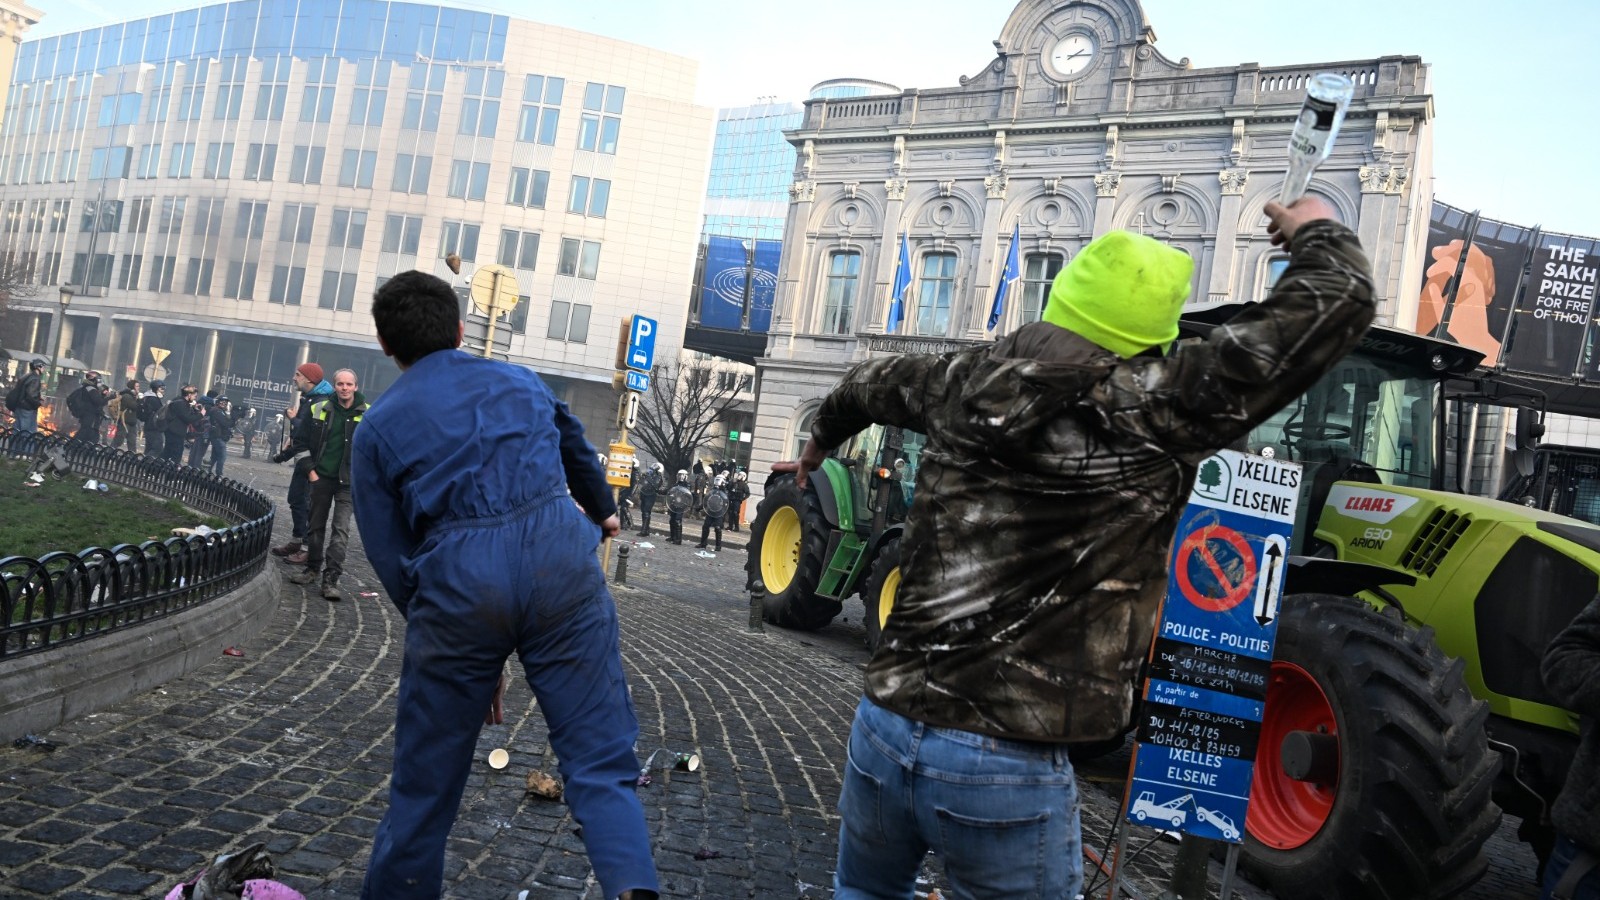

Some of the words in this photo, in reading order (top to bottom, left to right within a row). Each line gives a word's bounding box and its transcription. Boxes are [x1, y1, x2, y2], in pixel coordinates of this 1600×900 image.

[1548, 244, 1587, 264] THE
[1543, 262, 1597, 283] SAKH
[1540, 279, 1594, 300] PRIZE
[1536, 296, 1562, 309] FOR
[1565, 300, 1590, 313] FRE
[1533, 308, 1552, 320] OF
[1554, 311, 1588, 325] THOU
[635, 318, 652, 347] P
[1359, 336, 1414, 355] RION
[1237, 459, 1299, 488] IXELLES
[1232, 487, 1292, 516] ELSENE
[1344, 496, 1396, 513] CLAAS
[1349, 536, 1385, 550] ARION
[1363, 527, 1393, 541] 630
[1164, 621, 1210, 641] POLICE
[1219, 632, 1270, 653] POLITIE
[1161, 652, 1175, 662] DU
[1154, 694, 1176, 706] Vanaf
[1155, 683, 1162, 692] A
[1165, 683, 1187, 697] partir
[1189, 690, 1199, 699] de
[1149, 716, 1165, 729] DU
[1169, 719, 1220, 740] 11/12/25
[1149, 730, 1189, 748] 10H00
[1206, 741, 1241, 757] 23H59
[1168, 747, 1223, 768] IXELLES
[1167, 766, 1219, 787] ELSENE
